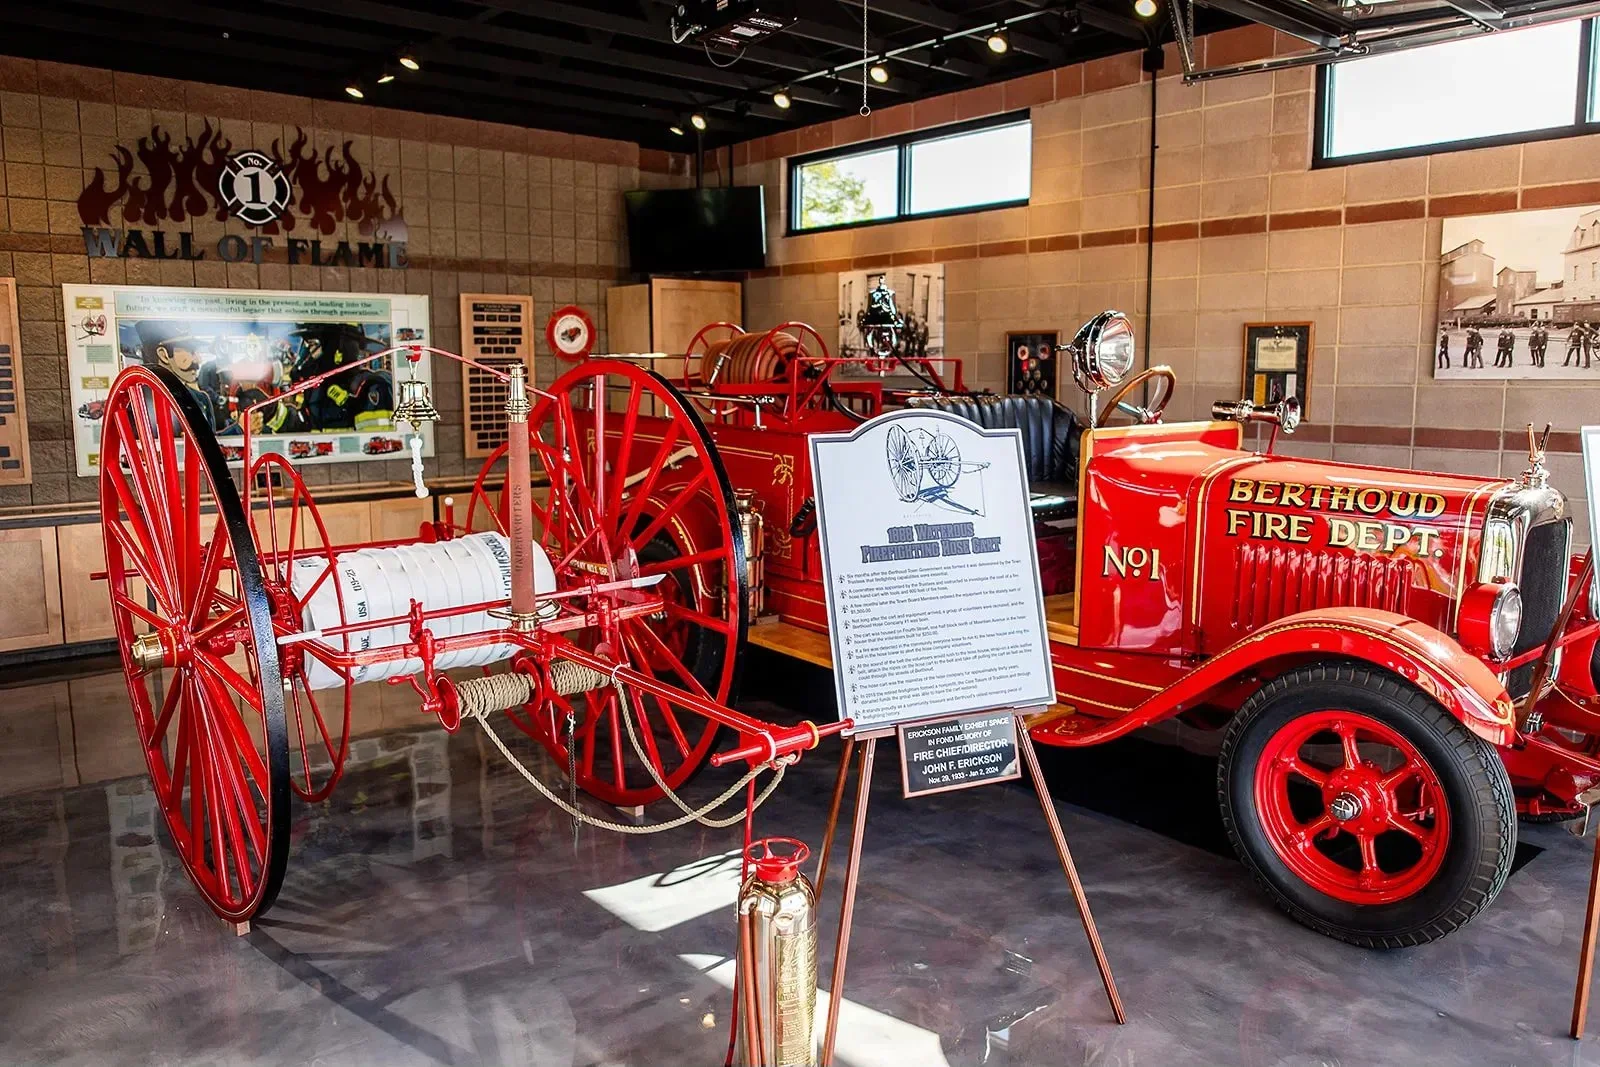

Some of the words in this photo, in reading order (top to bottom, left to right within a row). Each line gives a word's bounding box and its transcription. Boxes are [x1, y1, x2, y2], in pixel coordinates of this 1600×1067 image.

[247, 156, 262, 166] No.
[243, 171, 267, 204] 1
[80, 227, 205, 260] WALL
[217, 235, 274, 264] OF
[287, 238, 409, 269] FLAME
[226, 298, 246, 307] living
[319, 301, 344, 310] leading
[242, 307, 265, 315] legacy
[310, 309, 338, 317] through
[1229, 479, 1447, 520] BERTHOUD
[513, 485, 523, 572] UNDERWRITERS
[1226, 509, 1314, 544] FIRE
[1328, 517, 1444, 559] DEPT.
[357, 601, 368, 618] USA
[908, 728, 941, 739] ERICKSON
[942, 724, 964, 734] FAMILY
[965, 720, 988, 731] EXHIBIT
[989, 717, 1009, 726] SPACE
[936, 736, 954, 745] FOND
[955, 732, 982, 742] MEMORY
[913, 750, 935, 762] FIRE
[936, 738, 1008, 758] CHIEF/DIRECTOR
[922, 763, 947, 775] JOHN
[949, 761, 956, 771] F.
[958, 753, 1002, 769] ERICKSON
[969, 769, 979, 777] Jan
[985, 766, 999, 775] 2024
